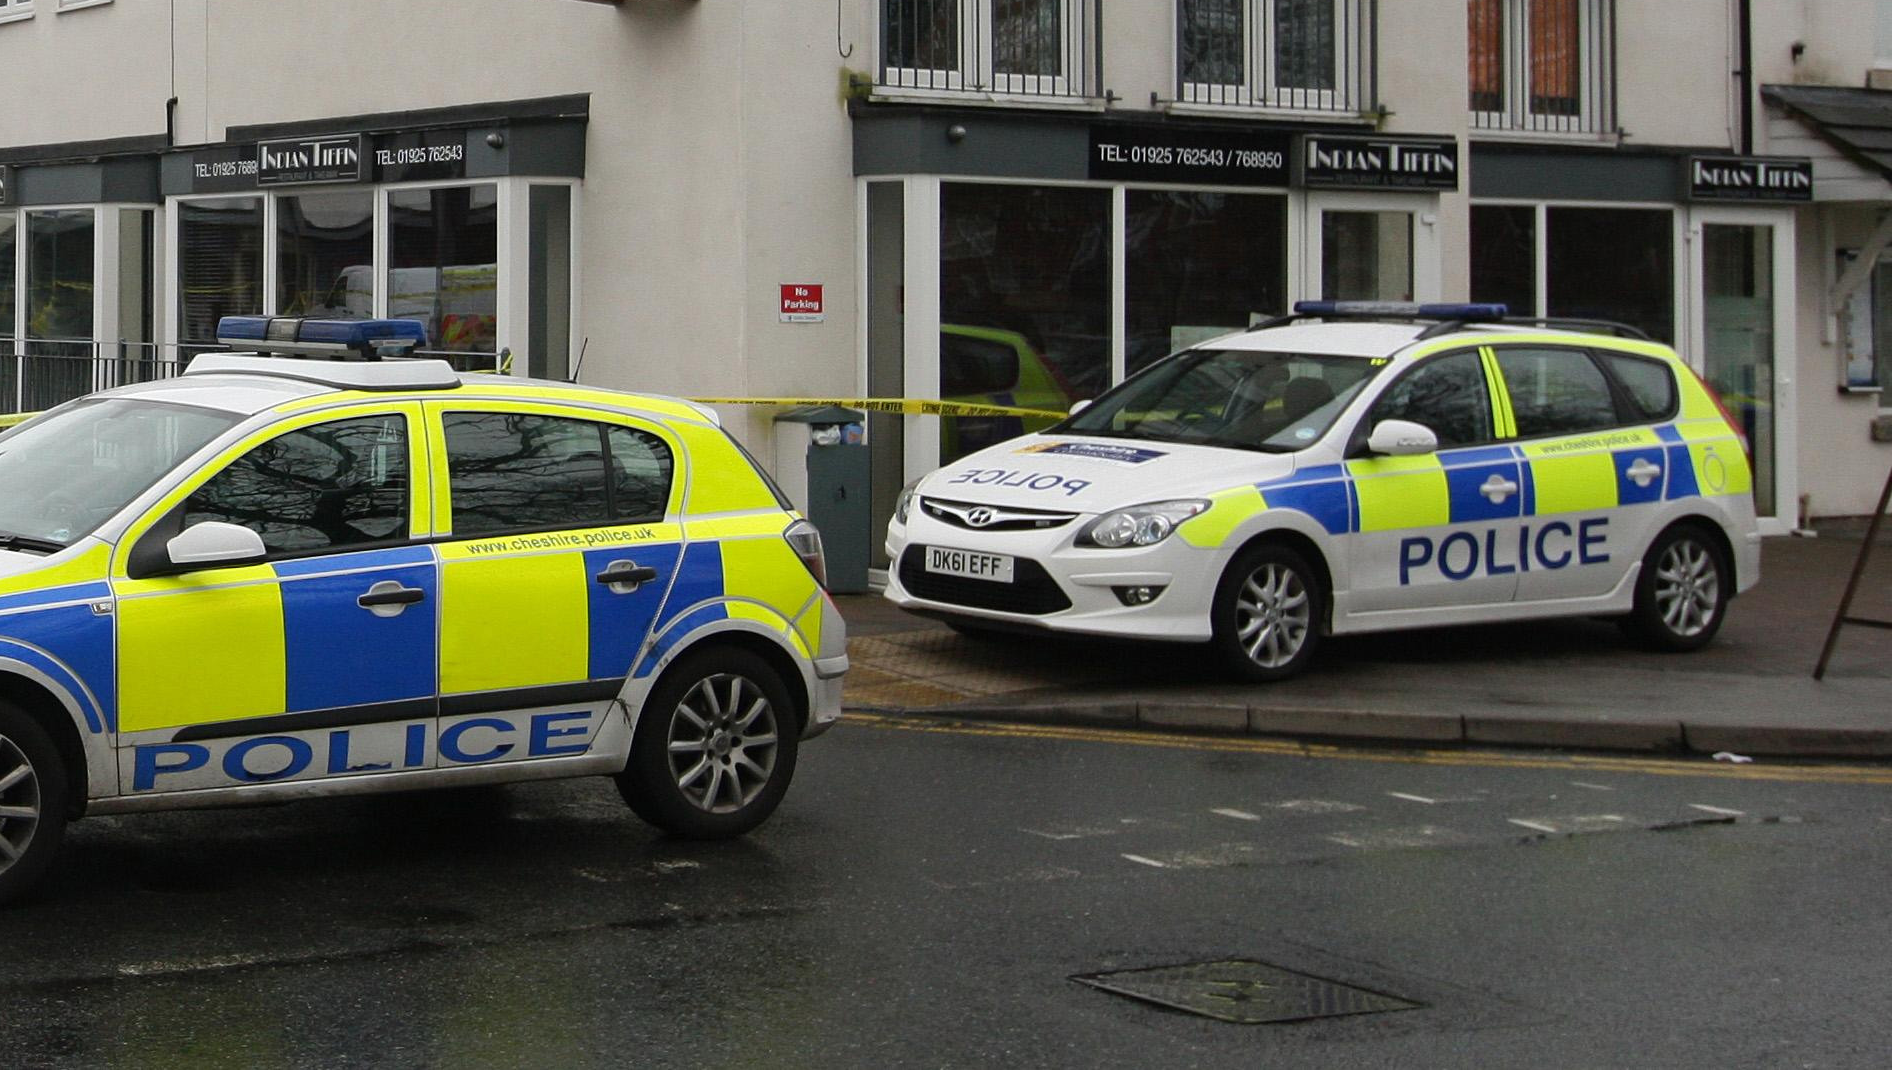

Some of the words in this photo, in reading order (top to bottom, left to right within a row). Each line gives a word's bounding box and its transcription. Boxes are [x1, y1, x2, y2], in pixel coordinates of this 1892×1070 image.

[261, 146, 308, 170] INDIAN
[376, 150, 396, 165] TEL:
[398, 147, 426, 164] 01925
[428, 145, 463, 162] 762543
[1098, 144, 1128, 162] TEL:
[1131, 146, 1172, 164] 01925
[1176, 148, 1224, 166] 762543
[1226, 150, 1232, 166] /
[1235, 150, 1282, 169] 768950
[195, 163, 212, 178] TEL:
[212, 162, 236, 176] 01925
[795, 287, 808, 296] No
[784, 300, 819, 310] Parking
[466, 527, 656, 554] www.cheshire.police.uk
[1399, 517, 1610, 586] POLICE
[933, 550, 965, 572] DK61
[970, 556, 1001, 577] EFF
[132, 710, 593, 791] POLICE
